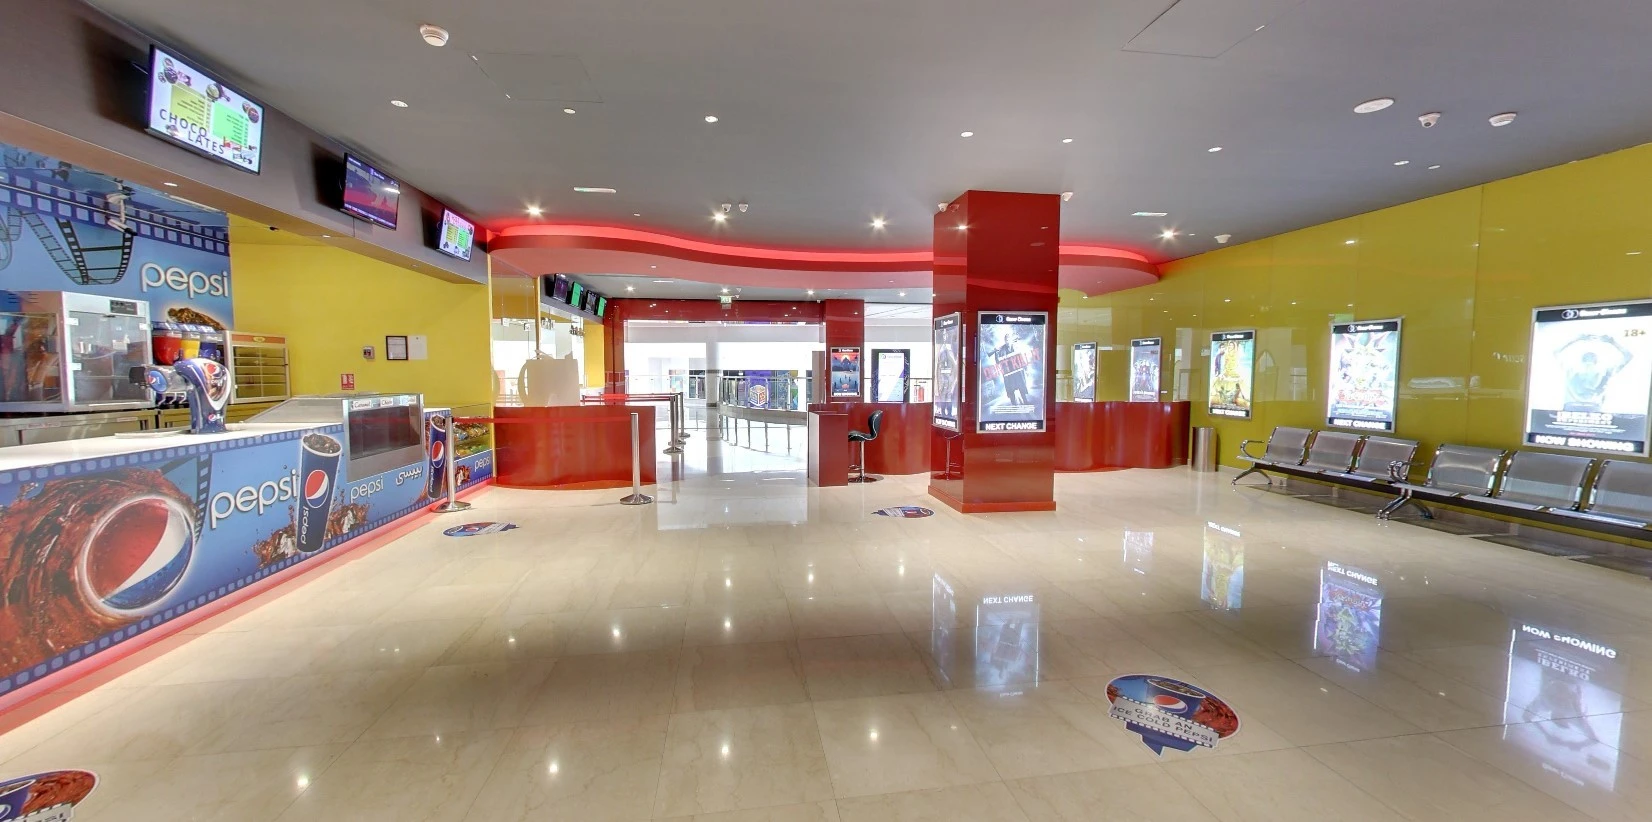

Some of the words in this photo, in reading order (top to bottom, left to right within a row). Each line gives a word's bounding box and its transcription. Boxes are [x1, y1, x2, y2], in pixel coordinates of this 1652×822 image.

[159, 108, 207, 138] CHOCO
[188, 131, 225, 154] LATES
[141, 263, 228, 298] pepsi
[1624, 329, 1646, 337] 18+
[1006, 422, 1037, 430] CHANGE
[1535, 434, 1566, 446] NOW
[1567, 437, 1634, 452] SHOWING
[211, 469, 297, 529] pepsi
[351, 475, 384, 503] pepsi
[301, 506, 309, 544] pepsi
[1113, 706, 1132, 715] ICE
[1136, 713, 1171, 728] COLD
[1175, 726, 1213, 742] PEPSI
[1134, 707, 1170, 723] GRAB
[1175, 721, 1193, 730] AN
